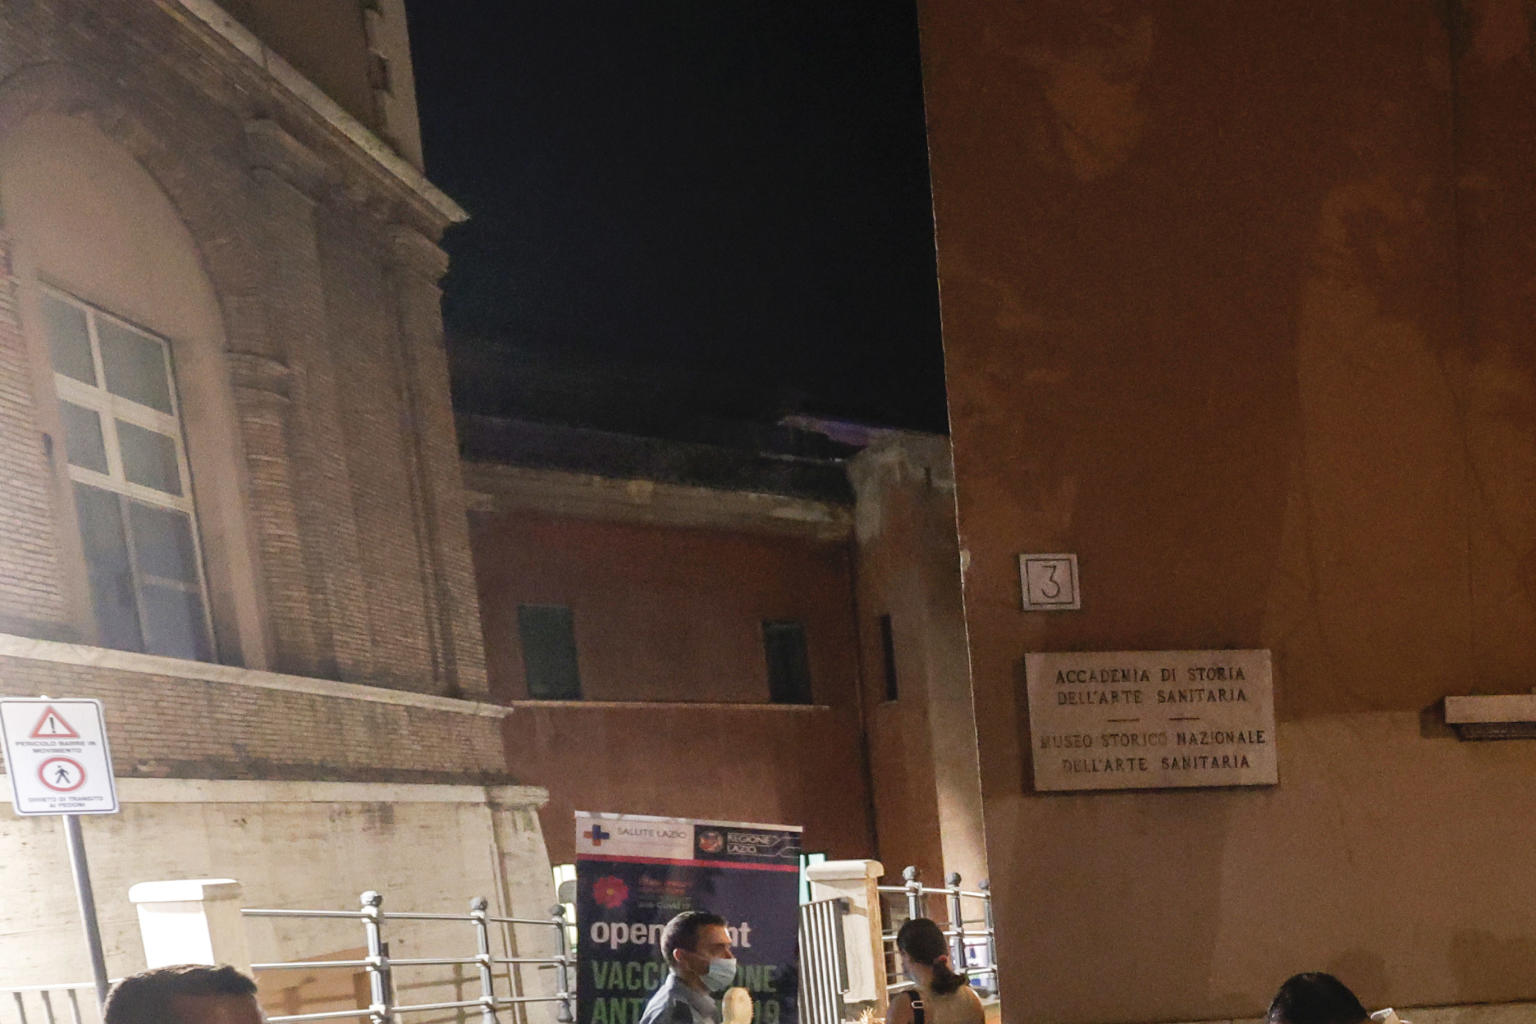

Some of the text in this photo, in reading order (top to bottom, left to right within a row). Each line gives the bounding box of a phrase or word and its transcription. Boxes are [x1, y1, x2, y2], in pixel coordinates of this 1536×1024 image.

[1040, 564, 1061, 599] 3
[1055, 666, 1246, 685] ACCADEMIA DI STORIA
[1057, 688, 1248, 706] DELL'ARTE SANITARIA
[1040, 729, 1266, 749] MUSEO STORICO NAZIONALE
[1062, 755, 1251, 774] DELL'ARTE SANITARIA
[616, 827, 688, 840] SALUTE LAZIO
[727, 833, 770, 846] REGIONE
[727, 845, 758, 855] LAZIO
